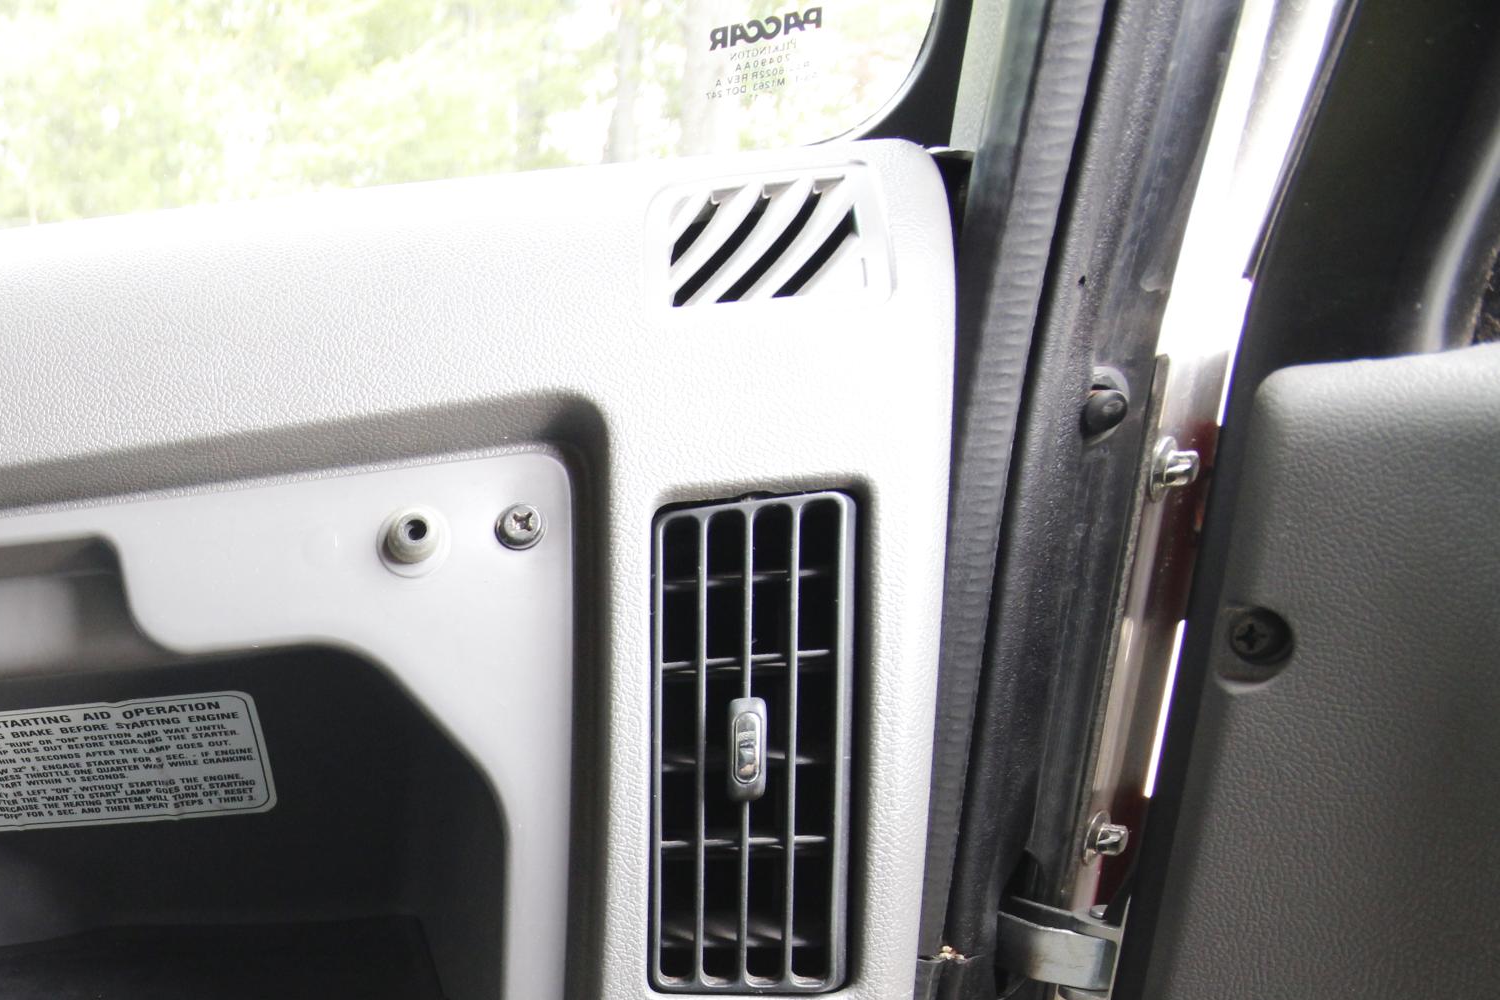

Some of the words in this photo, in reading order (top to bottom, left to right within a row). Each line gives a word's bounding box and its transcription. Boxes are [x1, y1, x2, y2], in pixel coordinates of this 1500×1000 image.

[83, 711, 111, 721] AID
[122, 701, 220, 720] OPERATION
[11, 729, 54, 739] BRAKE
[60, 723, 109, 734] BEFORE
[116, 717, 181, 730] STARTING
[188, 712, 239, 723] ENGINE
[68, 741, 105, 750] BEFORE
[109, 736, 162, 746] ENGAGING
[192, 730, 239, 739] STARTER.
[84, 733, 132, 741] POSITION
[35, 753, 81, 762] SECONDS
[144, 745, 171, 753] LAMP
[177, 742, 203, 750] GOES
[43, 762, 82, 770] ENGAGE
[86, 759, 128, 767] STARTER
[215, 748, 253, 756] ENGINE
[25, 770, 70, 779] THROTTLE
[97, 764, 139, 774] QUARTER
[143, 762, 164, 770] WAY
[203, 755, 256, 765] CRANKING.
[27, 778, 62, 786] WITHIN
[80, 773, 128, 781] SECONDS.
[80, 783, 123, 792] WITHOUT
[129, 779, 175, 788] STARTING
[180, 776, 200, 784] THE
[209, 780, 256, 789] STARTING
[1, 805, 39, 813] BECAUSE
[63, 800, 101, 808] HEATING
[174, 800, 204, 808] STEPS
